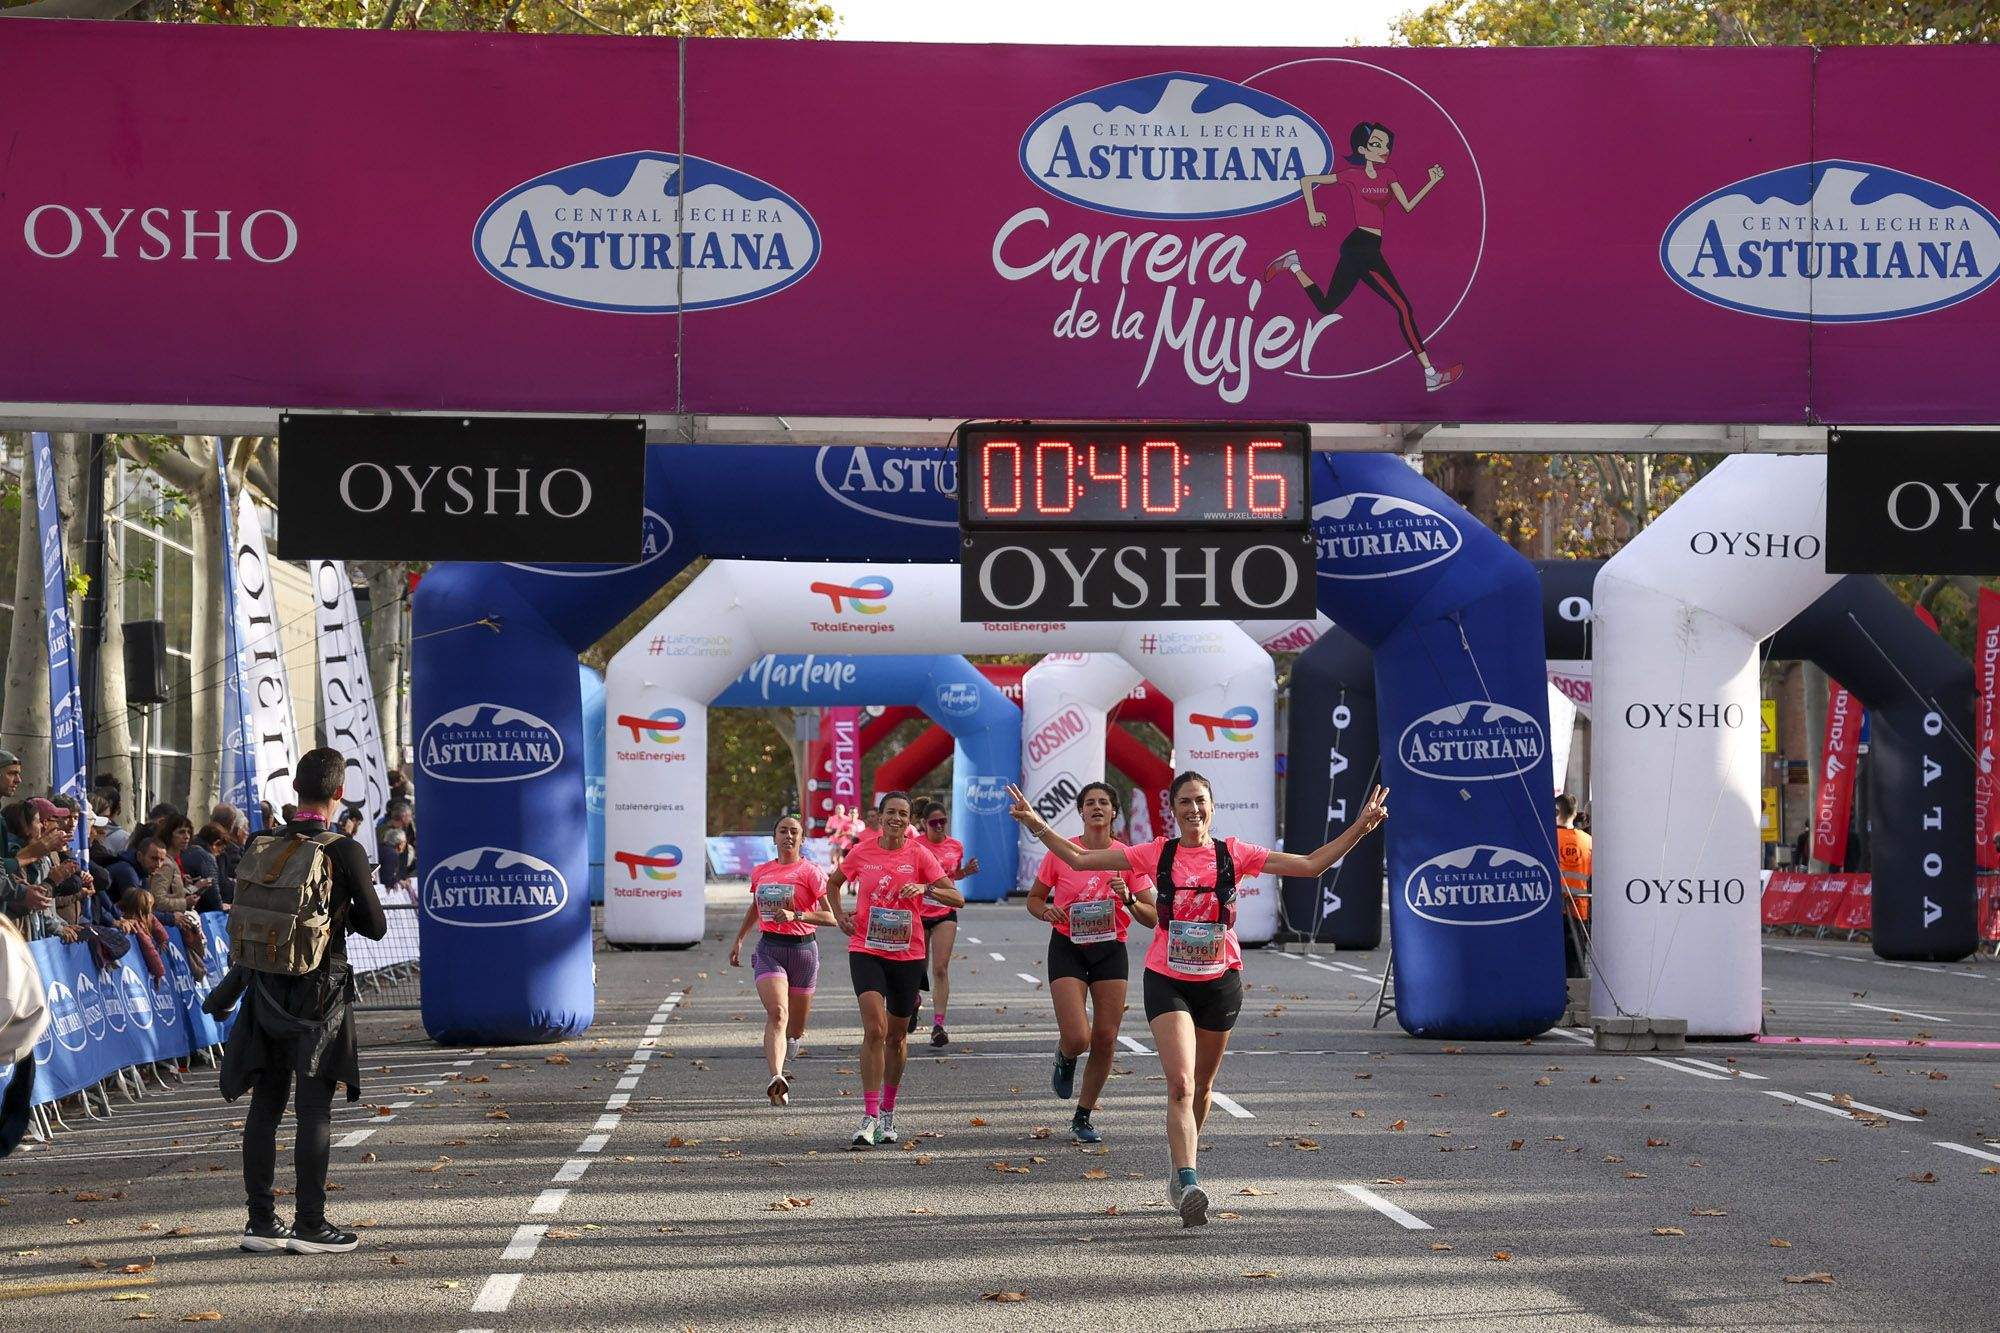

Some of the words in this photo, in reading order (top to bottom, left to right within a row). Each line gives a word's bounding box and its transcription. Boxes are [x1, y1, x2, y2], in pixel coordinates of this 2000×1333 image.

[1093, 123, 1190, 138] CENTRAL
[1200, 125, 1299, 139] LECHERA
[1044, 124, 1306, 182] ASTURIANA
[555, 207, 662, 223] CENTRAL
[674, 208, 783, 223] LECHERA
[1742, 216, 1848, 231] CENTRAL
[1861, 217, 1971, 231] LECHERA
[23, 204, 299, 263] OYSHO
[500, 209, 795, 271] ASTURIANA
[992, 207, 1247, 284] Carrera
[1687, 219, 1983, 280] ASTURIANA
[1053, 288, 1100, 340] de
[1112, 285, 1145, 340] la
[1137, 279, 1344, 404] Mujer
[339, 462, 592, 518] OYSHO
[1204, 511, 1284, 520] WWW.PIXELCOM.ES
[1887, 481, 2000, 531] OY
[1312, 523, 1373, 535] ENTRAL
[1379, 518, 1440, 530] LECHERA
[1315, 530, 1451, 560] STURIANA
[1690, 531, 1820, 559] OYSHO
[979, 544, 1299, 610] OYSHO
[810, 622, 895, 634] TotalEnergies
[983, 621, 1066, 633] TotalEnergies
[1553, 675, 1592, 703] COSM
[1625, 703, 1743, 729] OYSHO
[442, 730, 491, 740] CENTRAL
[498, 730, 549, 740] LECHERA
[1027, 709, 1084, 764] COSMO
[1429, 728, 1483, 739] CENTRAL
[1489, 726, 1534, 736] LECHERA
[425, 736, 555, 767] ASTURIANA
[616, 751, 686, 762] TotalEnergies
[1189, 750, 1260, 761] TotalEnergies
[1408, 733, 1539, 763] ASTURIANA
[1214, 801, 1259, 810] nergies.es
[1923, 711, 1943, 928] VOLVO
[446, 874, 495, 884] CENTRAL
[501, 874, 553, 883] LECHERA
[1435, 872, 1489, 883] CENTRAL
[1495, 870, 1541, 880] LECHERA
[430, 879, 558, 909] ASTURIANA
[614, 888, 682, 899] TotalEnergies
[1414, 876, 1546, 906] ASTURIANA
[1625, 878, 1745, 904] OYSHO
